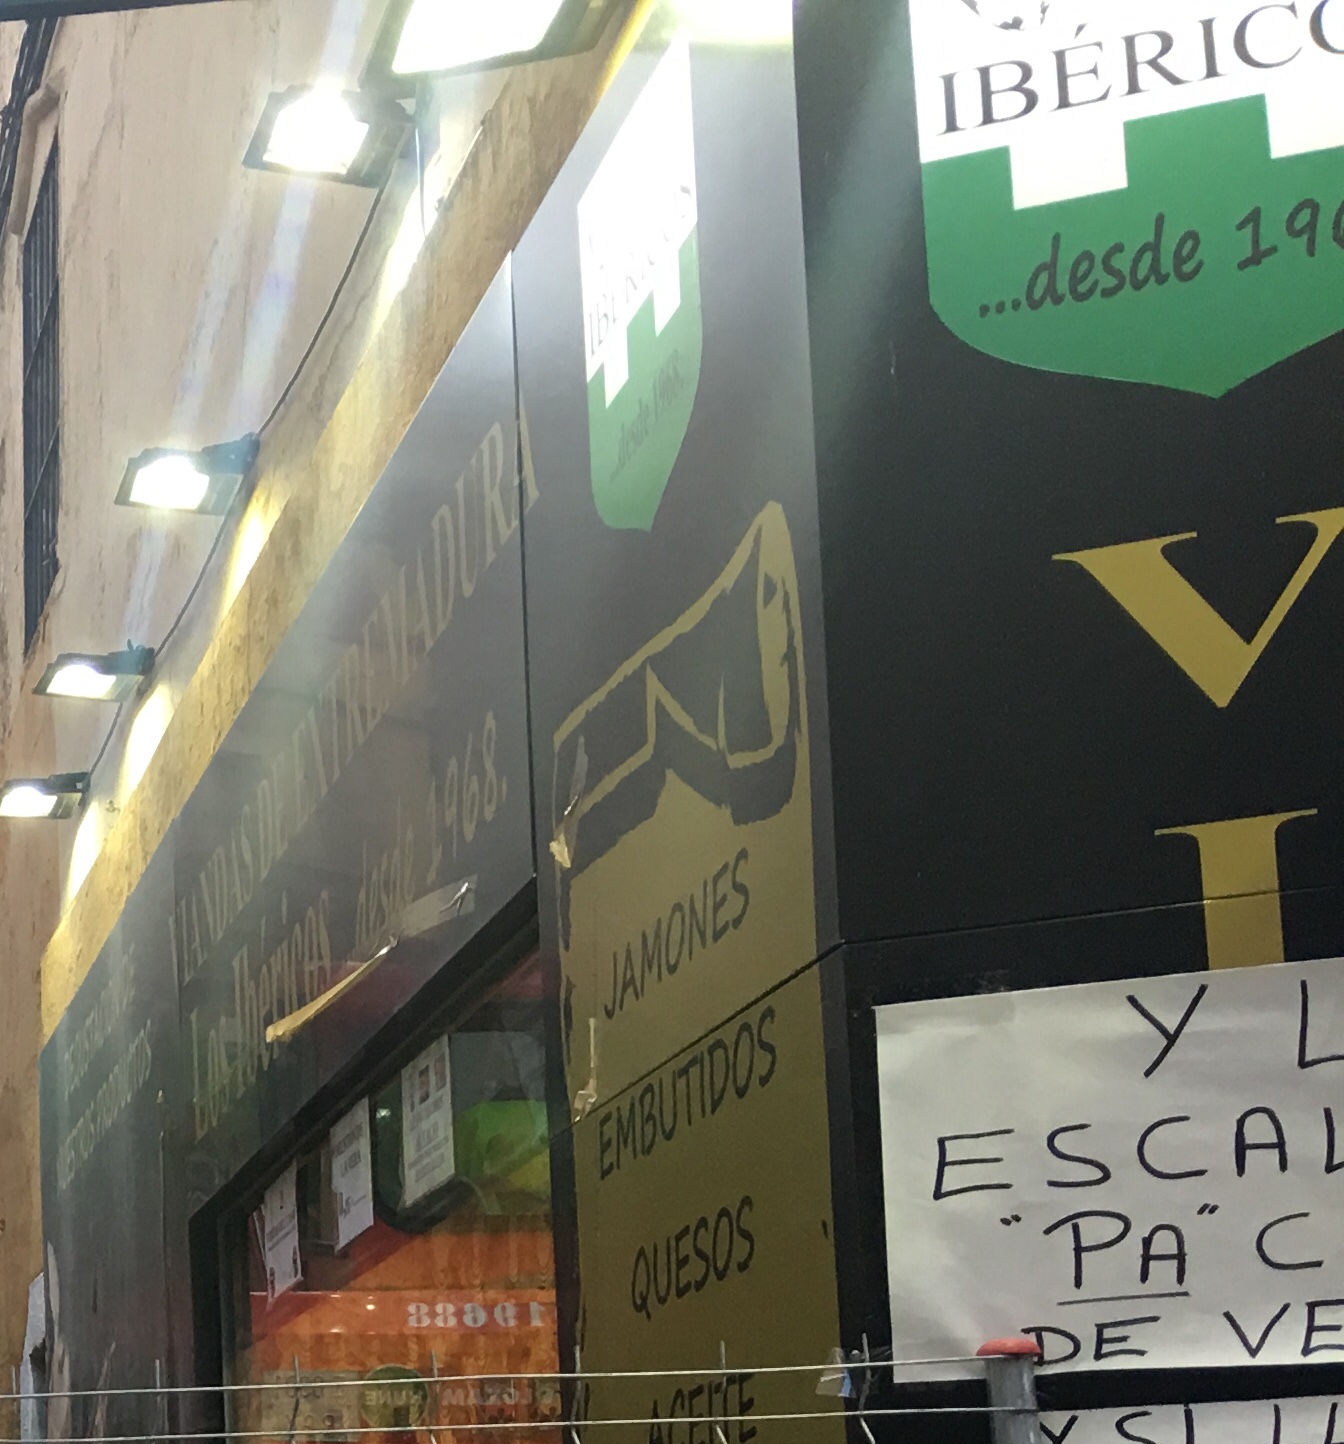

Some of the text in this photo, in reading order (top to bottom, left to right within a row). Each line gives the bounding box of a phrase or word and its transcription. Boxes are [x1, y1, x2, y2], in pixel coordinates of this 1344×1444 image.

[293, 390, 540, 832] EXTREMADURA
[604, 848, 749, 1021] JAMONES
[599, 1005, 777, 1181] EMBUTIDOS
[1126, 984, 1208, 1078] Y
[631, 1195, 755, 1322] QUESOS
